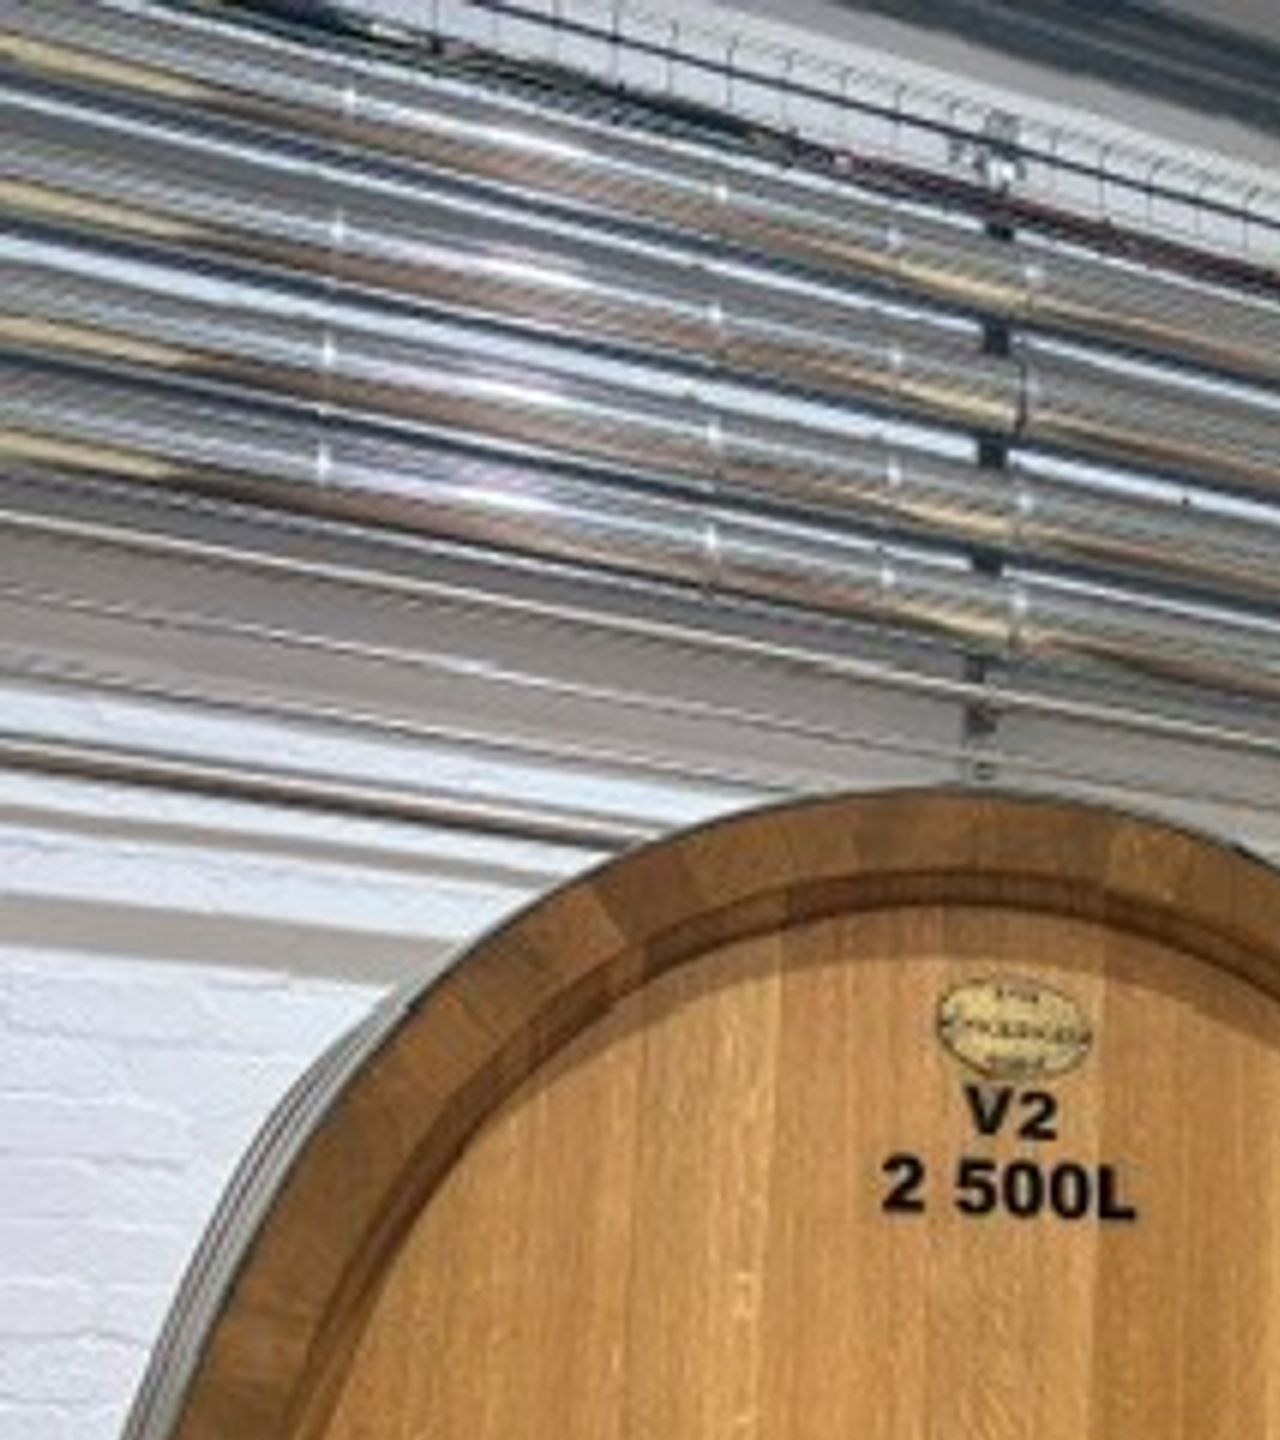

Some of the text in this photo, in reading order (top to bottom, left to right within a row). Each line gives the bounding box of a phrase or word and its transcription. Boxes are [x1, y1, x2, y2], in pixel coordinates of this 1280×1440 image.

[964, 1084, 1059, 1141] V2
[881, 1152, 1138, 1221] 2 500L
